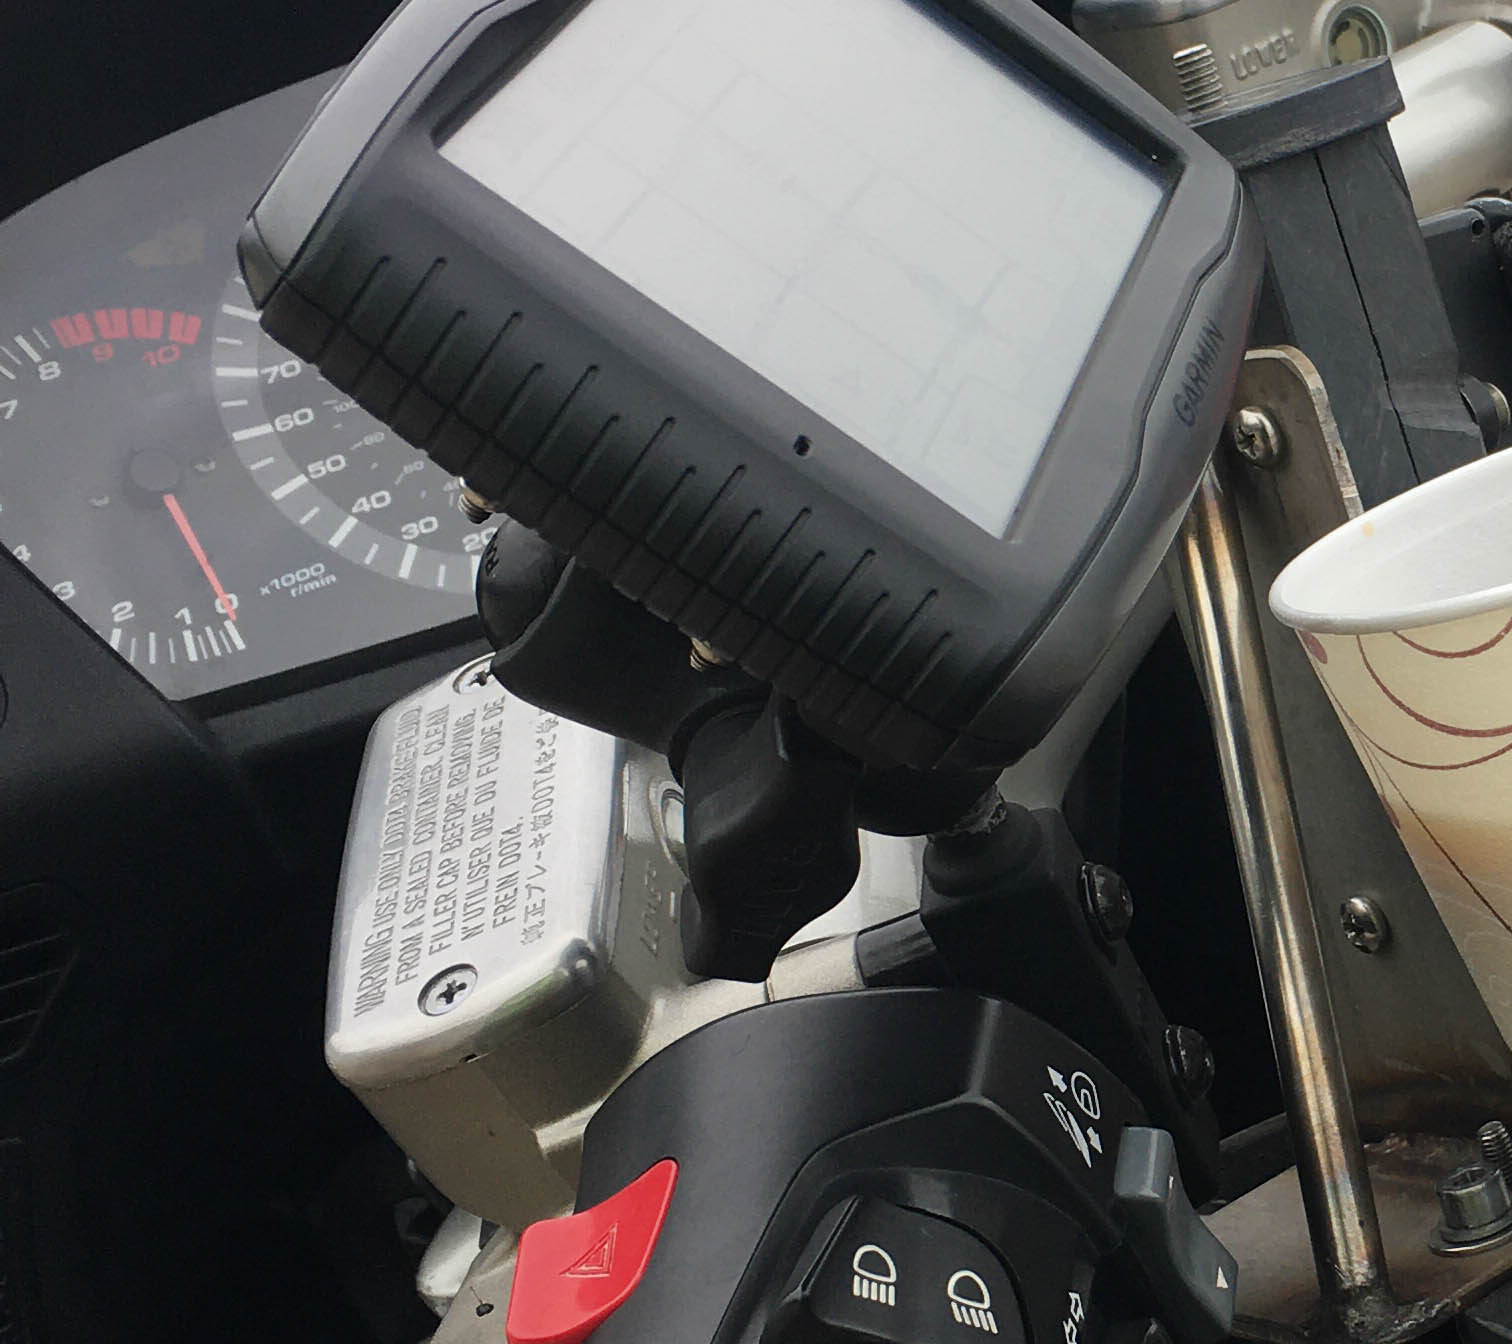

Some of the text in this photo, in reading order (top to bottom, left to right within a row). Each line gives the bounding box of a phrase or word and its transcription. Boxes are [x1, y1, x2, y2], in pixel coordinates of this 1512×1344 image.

[143, 343, 181, 367] 10
[38, 361, 61, 382] 8
[260, 359, 301, 384] 70
[1172, 316, 1225, 427] GARMIN
[274, 407, 314, 432] 60
[307, 454, 346, 479] 50
[352, 490, 391, 513] 40
[401, 516, 438, 540] 30
[462, 527, 498, 553] 20
[12, 544, 32, 562] 4
[52, 581, 76, 601] 3
[260, 563, 325, 596] x1000
[290, 574, 337, 598] r/min
[111, 601, 135, 622] 2
[174, 607, 192, 625] 1
[214, 593, 239, 614] 0
[481, 695, 506, 722] DE
[393, 706, 422, 752] FLUID
[424, 703, 450, 757] CLEAN
[477, 719, 503, 779] FLUIDE
[474, 780, 498, 807] DU
[440, 786, 469, 855] BEFORE
[471, 806, 495, 843] QUE
[377, 848, 404, 891] ONLY
[403, 850, 432, 915] SEALED
[436, 857, 461, 890] CAP
[372, 890, 399, 928] USE
[493, 870, 520, 929] FREIN
[402, 913, 425, 930] A
[428, 889, 457, 956] FILLER
[353, 925, 394, 1018] WARNING
[395, 931, 423, 986] FROM
